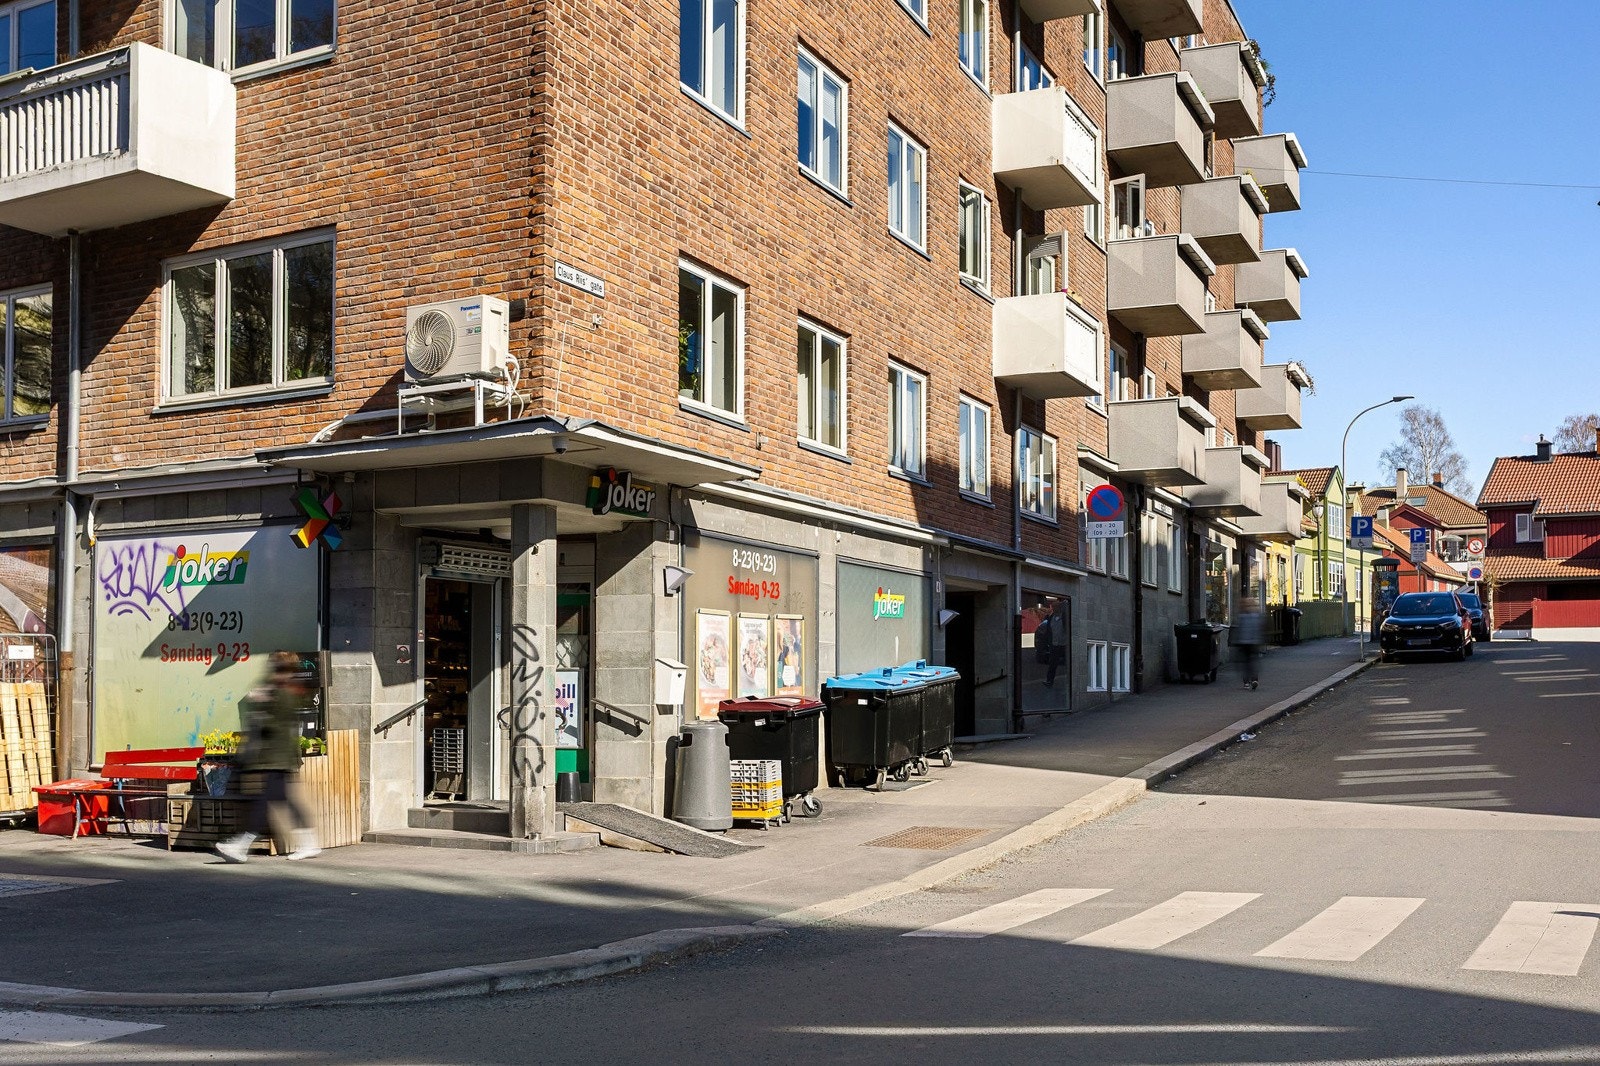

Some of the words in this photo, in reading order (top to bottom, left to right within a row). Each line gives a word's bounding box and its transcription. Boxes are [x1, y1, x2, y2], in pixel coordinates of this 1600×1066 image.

[557, 265, 574, 281] Claus
[590, 281, 603, 293] gate
[600, 466, 656, 515] joker
[1356, 518, 1369, 535] P
[1413, 529, 1422, 541] P
[166, 543, 244, 594] joker
[733, 548, 777, 576] 8-23(9-23)
[728, 575, 760, 601] Søndag
[761, 580, 780, 600] 9-23
[873, 587, 904, 621] joker
[160, 643, 213, 666] Søndag
[217, 643, 250, 662] 9-23
